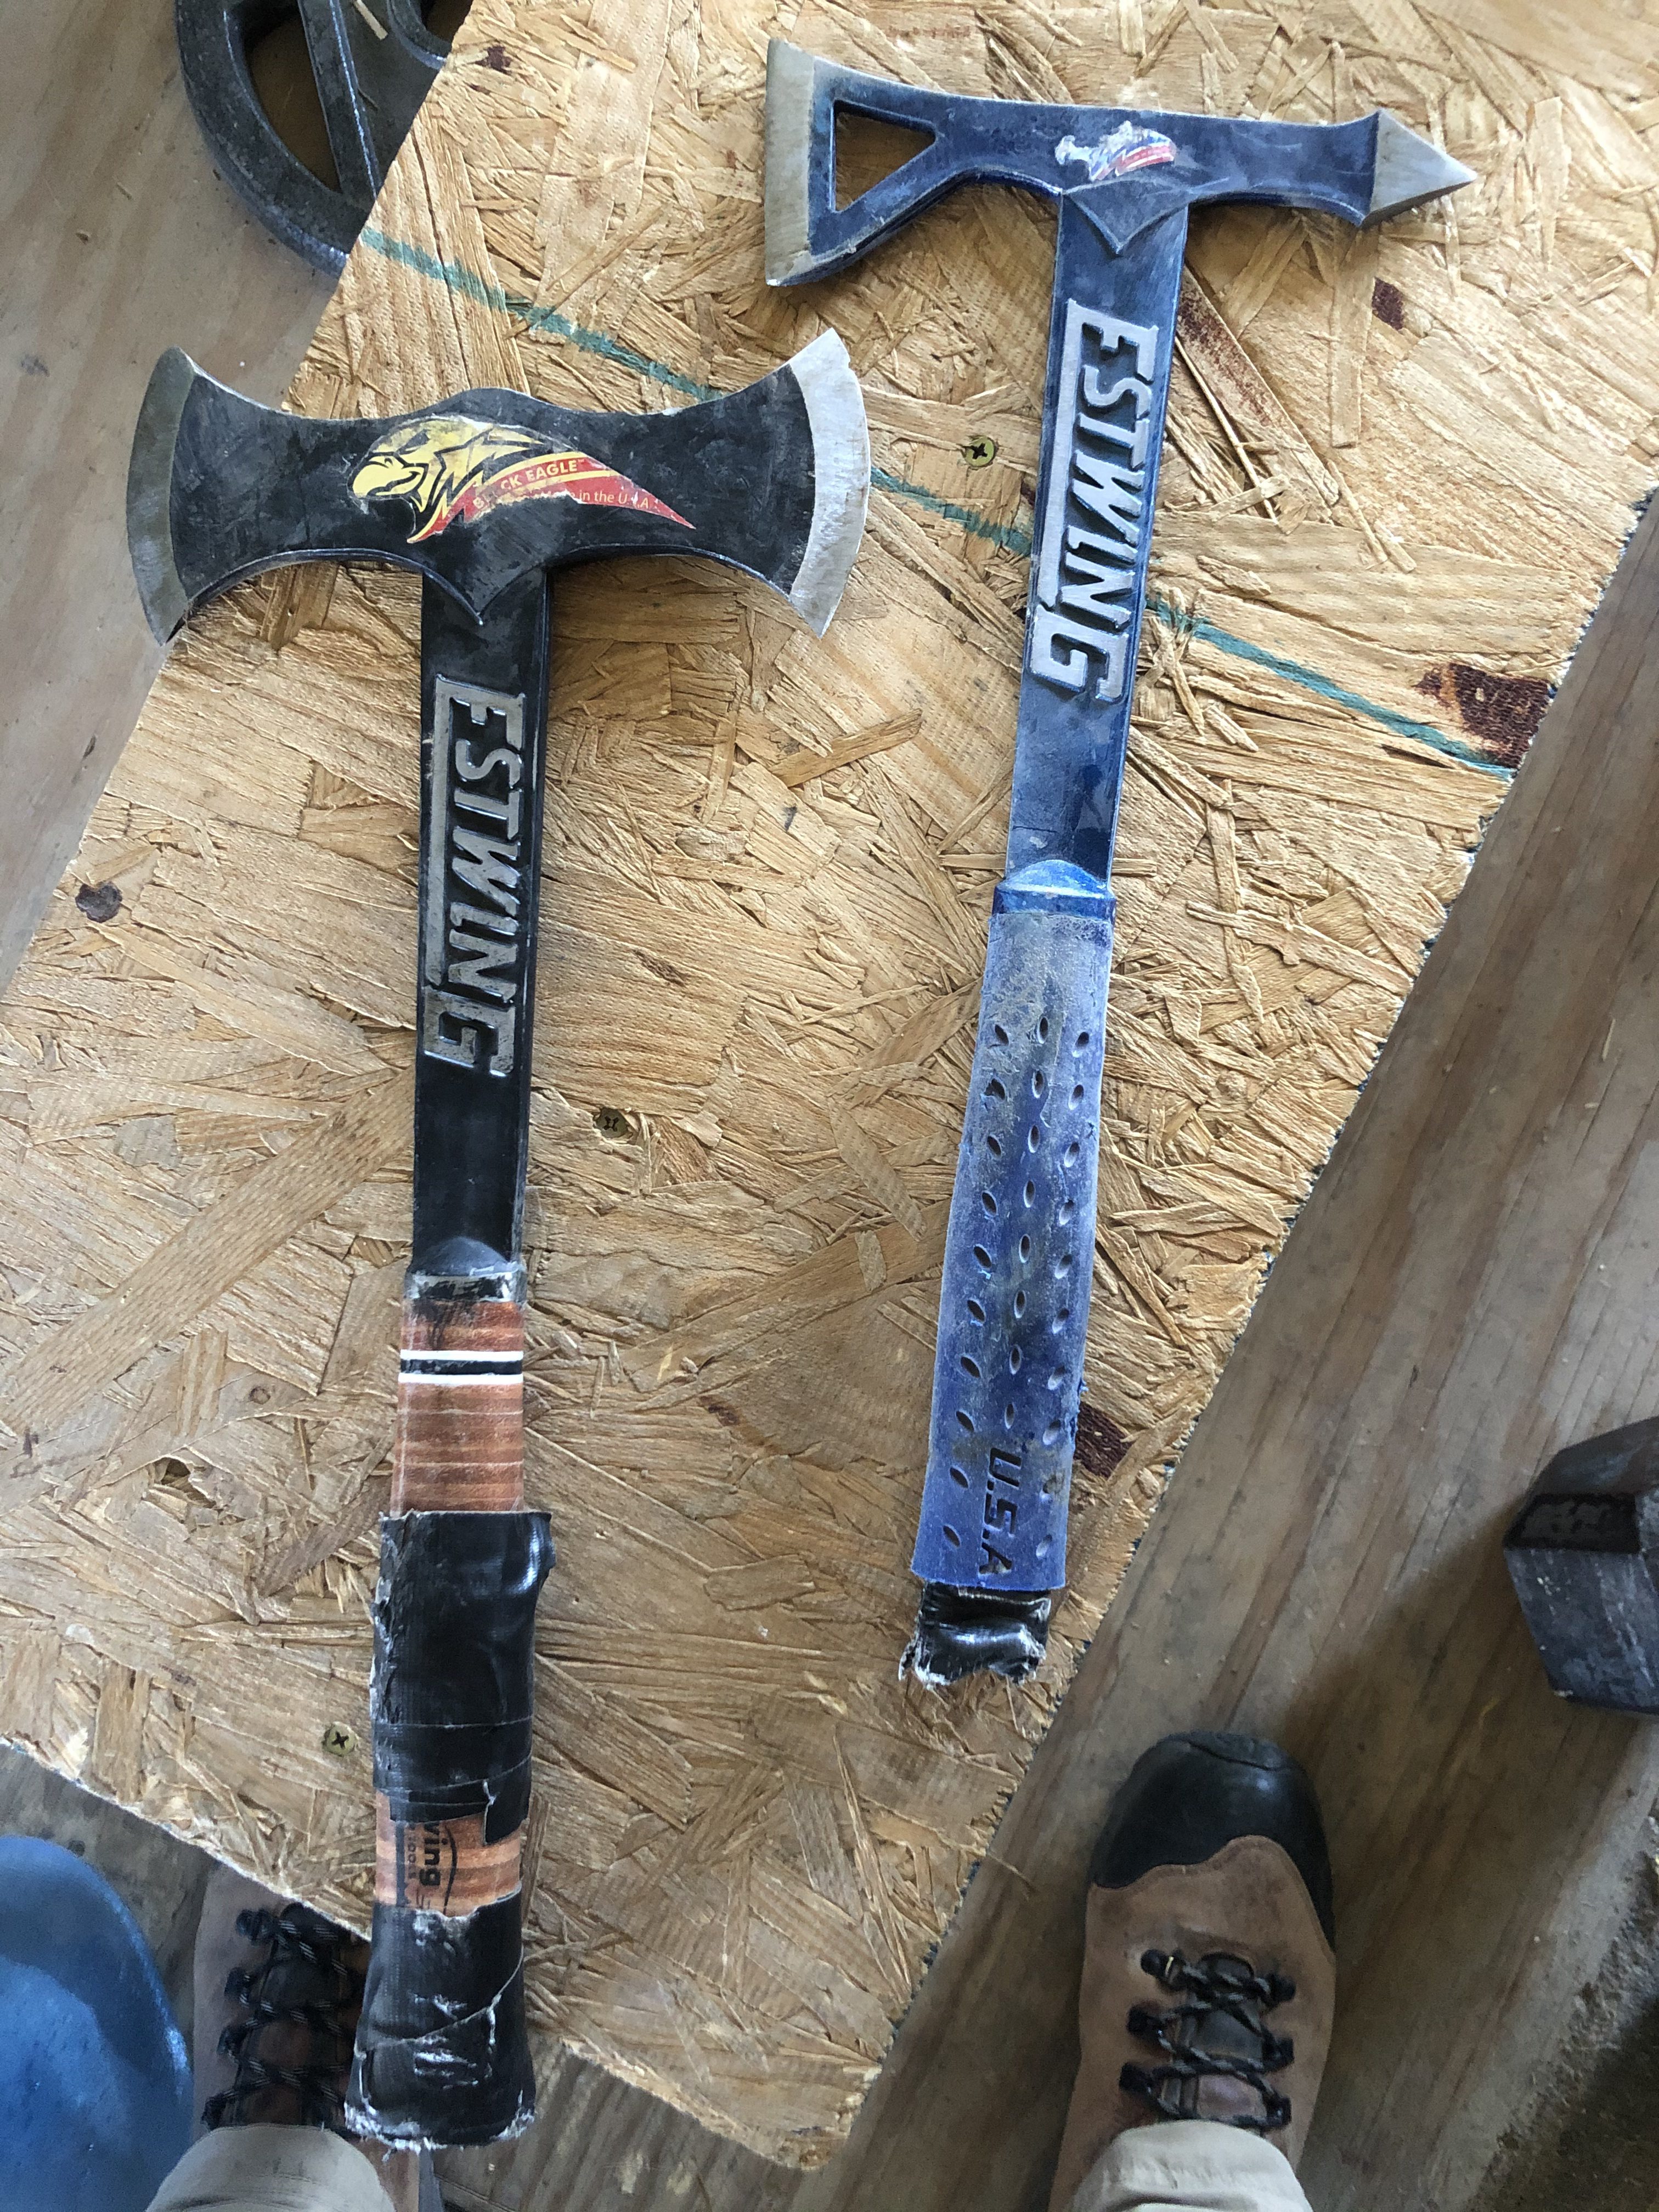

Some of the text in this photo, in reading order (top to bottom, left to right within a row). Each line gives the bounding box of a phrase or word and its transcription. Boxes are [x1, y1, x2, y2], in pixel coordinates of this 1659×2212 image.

[472, 474, 522, 509] BCK
[579, 489, 590, 501] in
[594, 491, 615, 503] the
[1030, 299, 1159, 699] ESTWING
[422, 674, 524, 1077] ESTWING
